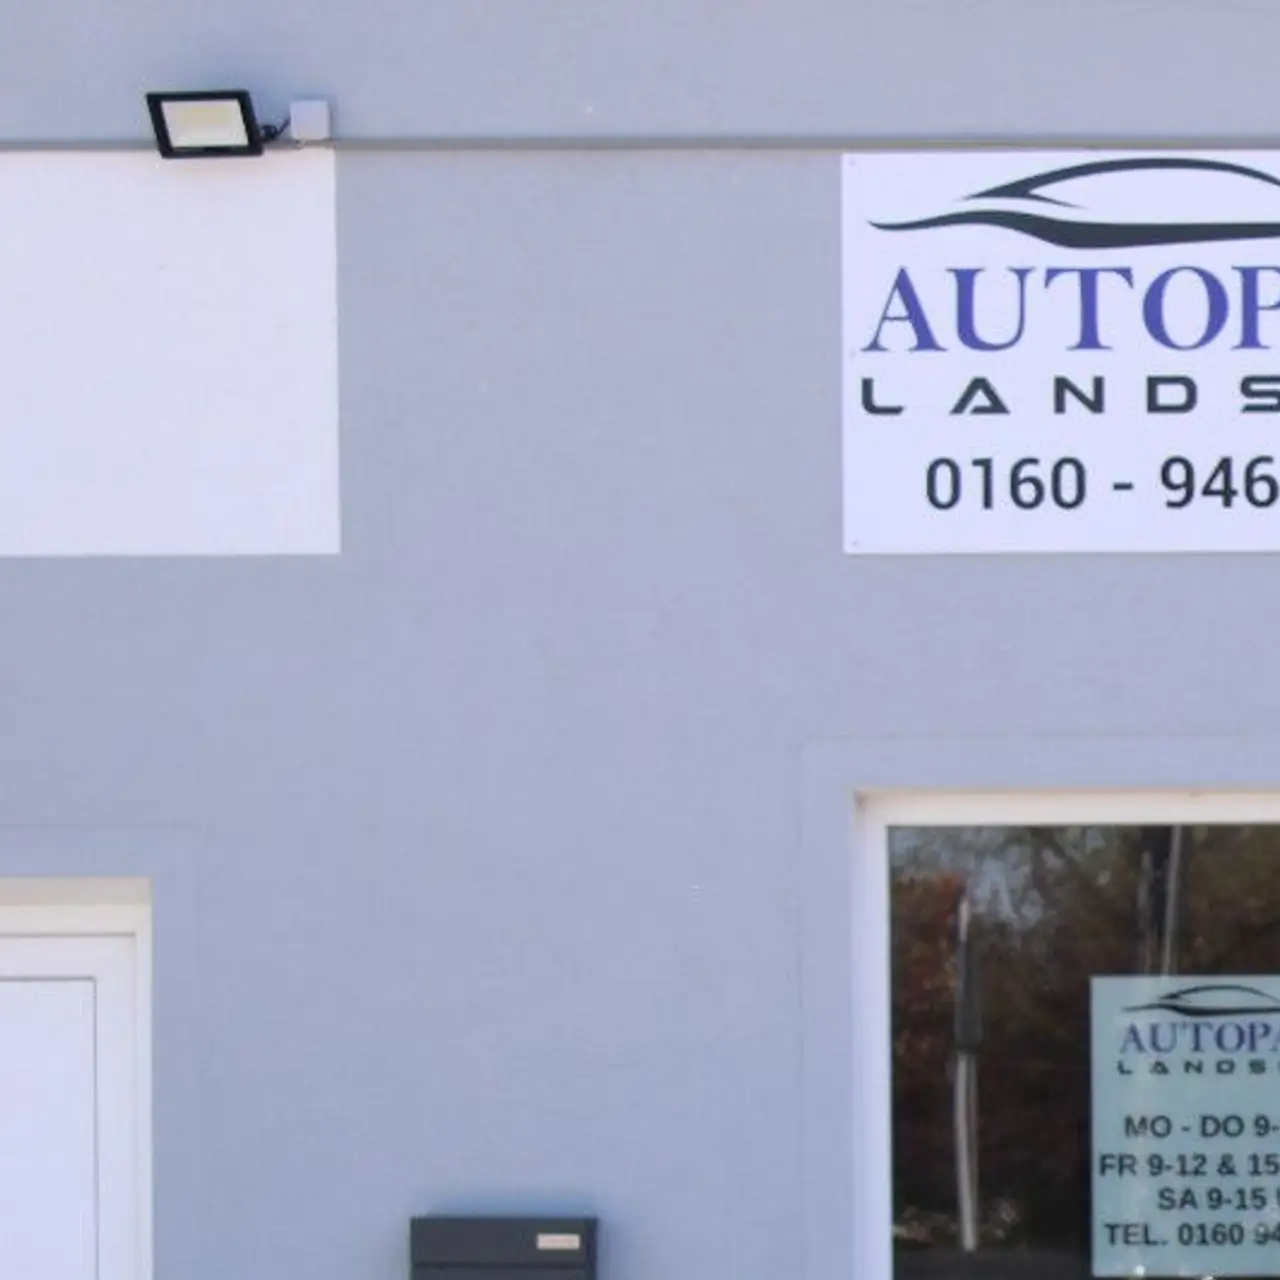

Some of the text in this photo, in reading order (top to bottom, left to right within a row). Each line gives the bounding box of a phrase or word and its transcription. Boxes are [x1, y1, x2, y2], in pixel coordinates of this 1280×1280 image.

[926, 456, 1086, 511] 0160
[1112, 482, 1134, 492] -
[1123, 1114, 1173, 1139] MO
[1200, 1114, 1246, 1139] DO
[1098, 1153, 1137, 1177] FR
[1147, 1153, 1208, 1178] 9-12
[1216, 1153, 1238, 1177] &
[1157, 1187, 1199, 1211] SA
[1206, 1187, 1268, 1211] 9-15
[1103, 1222, 1169, 1247] TEL.
[1177, 1222, 1245, 1247] 0160
